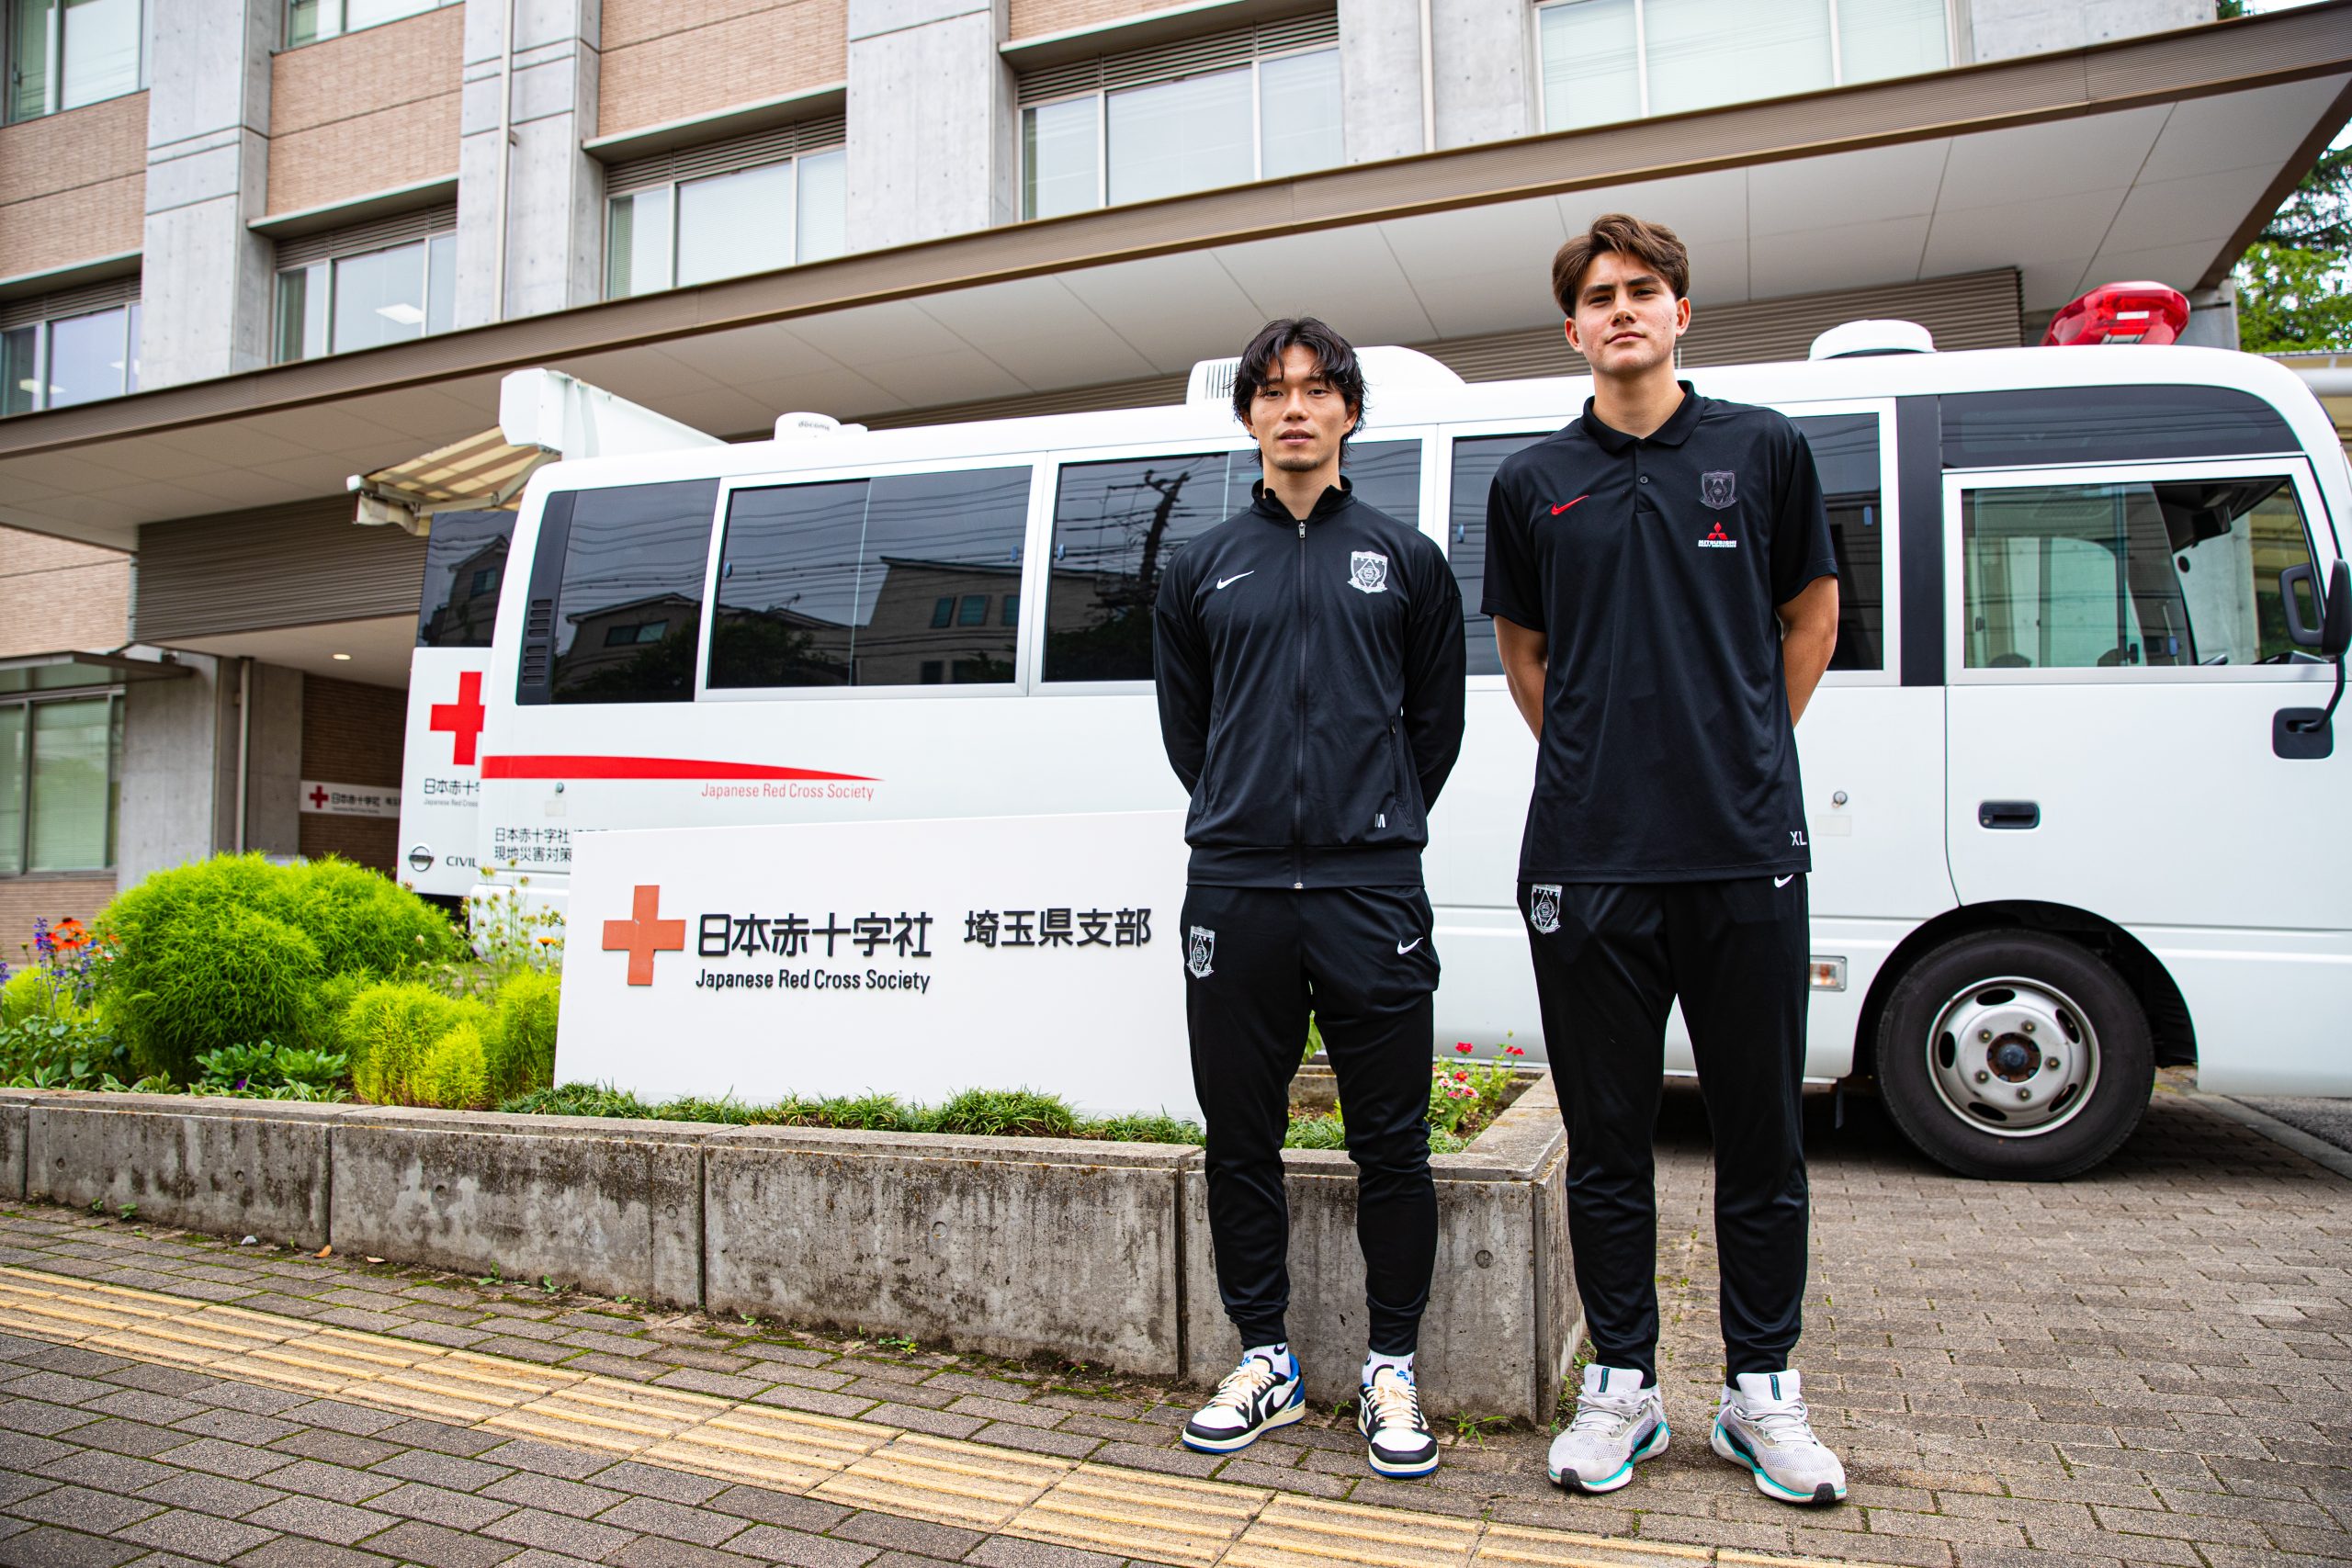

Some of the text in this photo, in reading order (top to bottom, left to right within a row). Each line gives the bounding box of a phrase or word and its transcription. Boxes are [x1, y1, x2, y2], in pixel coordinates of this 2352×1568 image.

[701, 784, 874, 801] Japanese Red Cross Society
[495, 827, 570, 843] 日本赤十字社
[1790, 831, 1807, 846] XL
[698, 908, 1151, 956] 日本赤十字社 埼玉県支部
[695, 969, 930, 994] Japanese Red Cross Society
